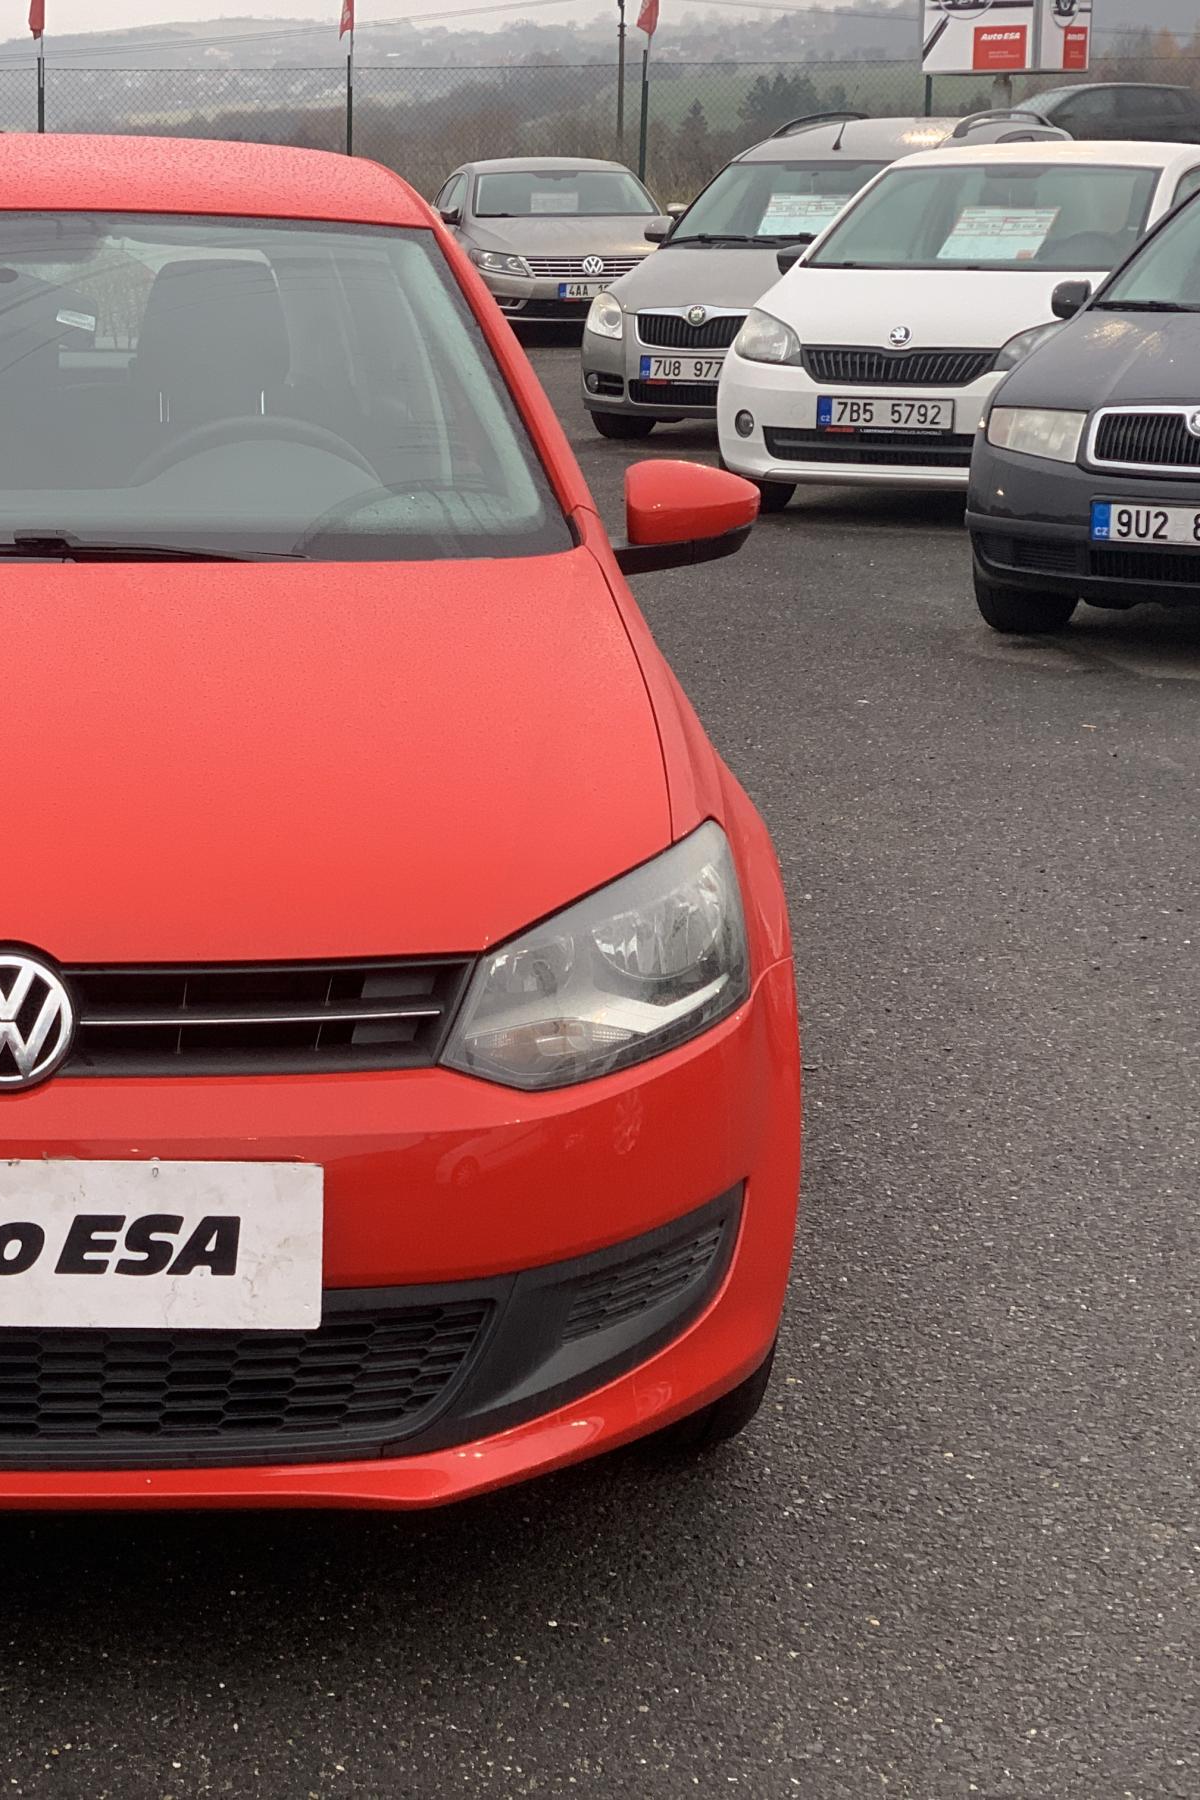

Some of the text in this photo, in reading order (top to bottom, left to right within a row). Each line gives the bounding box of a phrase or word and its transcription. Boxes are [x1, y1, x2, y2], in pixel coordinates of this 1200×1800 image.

[980, 32, 1021, 41] Auto ESA
[569, 284, 588, 296] 4AA
[654, 360, 681, 377] 7U8
[837, 402, 874, 423] 7B5
[891, 403, 941, 425] 5792
[1094, 526, 1109, 536] CZ
[1117, 509, 1169, 539] 9U2
[55, 1214, 241, 1277] ESA
